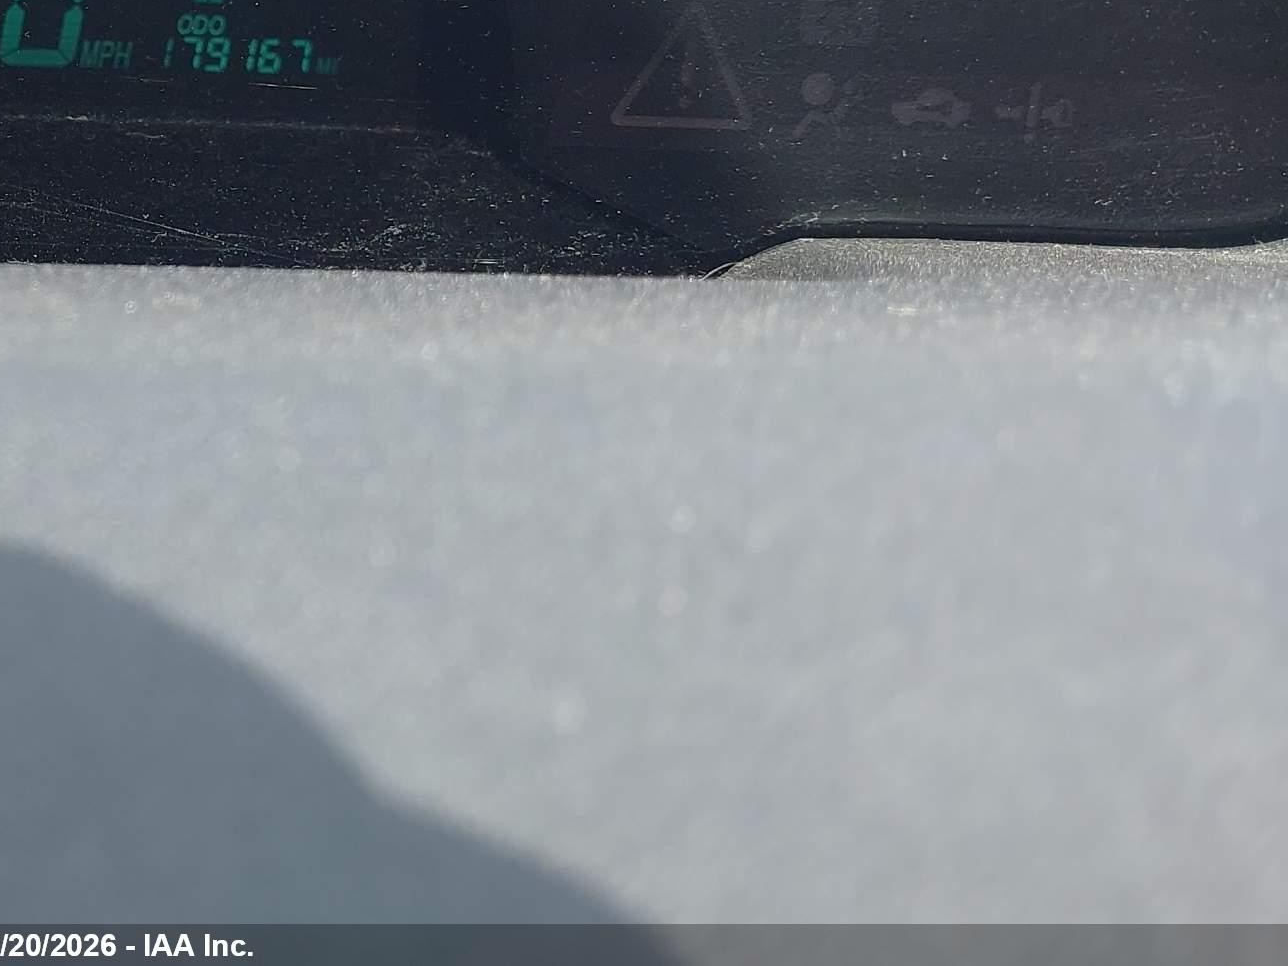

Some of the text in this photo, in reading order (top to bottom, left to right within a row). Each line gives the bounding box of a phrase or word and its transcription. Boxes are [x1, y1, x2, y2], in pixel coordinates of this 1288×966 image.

[176, 13, 227, 35] ODO
[80, 40, 133, 69] MPH
[163, 37, 313, 74] 179167
